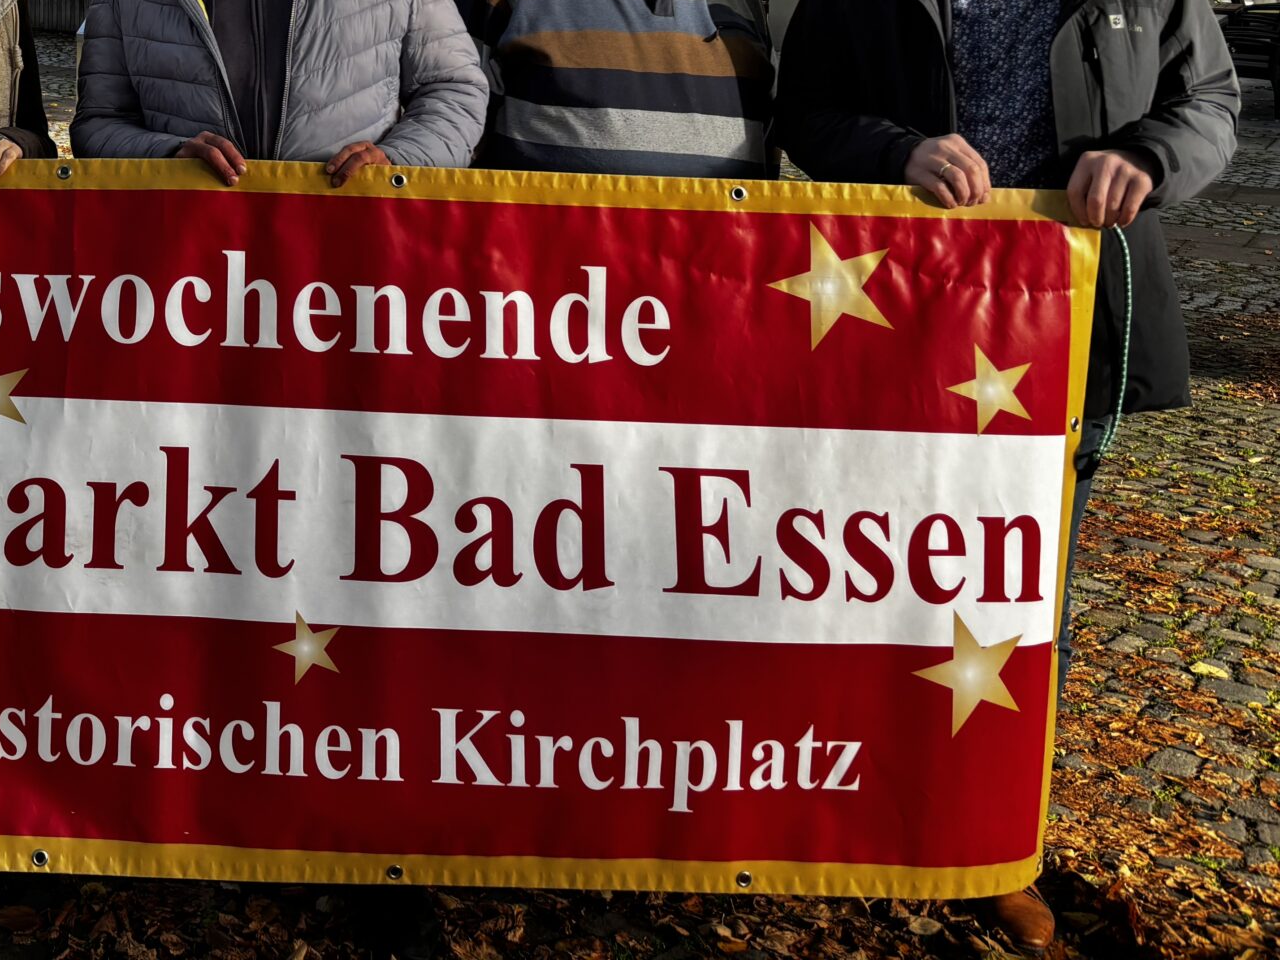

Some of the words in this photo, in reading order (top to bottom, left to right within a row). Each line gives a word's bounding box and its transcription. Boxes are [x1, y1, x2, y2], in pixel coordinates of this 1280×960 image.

[338, 456, 613, 591] Bad
[661, 467, 1044, 605] Essen
[431, 707, 863, 813] Kirchplatz
